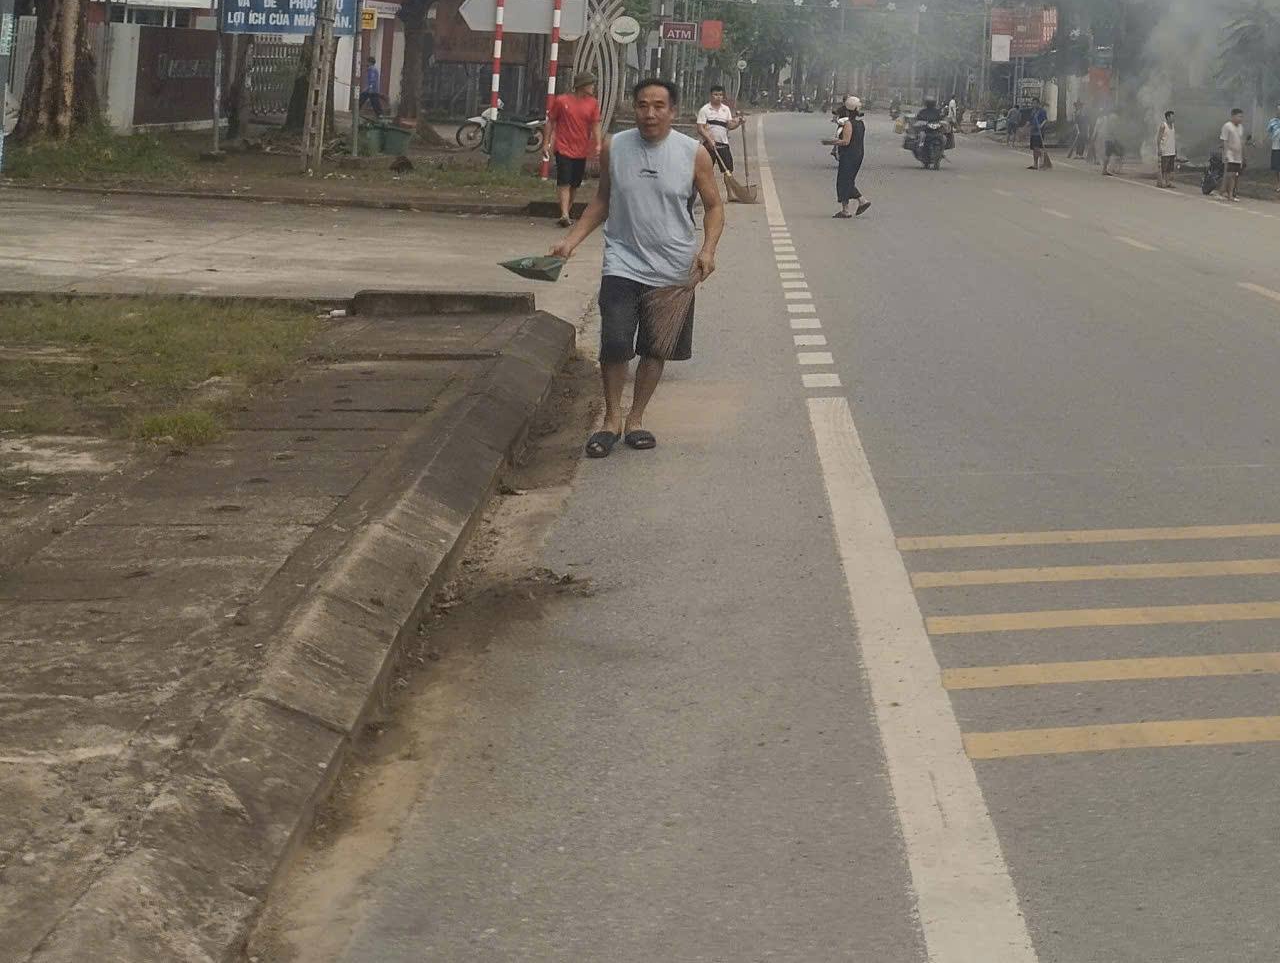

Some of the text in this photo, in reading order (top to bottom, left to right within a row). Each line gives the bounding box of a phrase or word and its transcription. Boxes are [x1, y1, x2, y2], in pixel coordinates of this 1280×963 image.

[269, 10, 290, 26] CỦA
[293, 12, 316, 27] NHÂ
[667, 29, 691, 39] ATM
